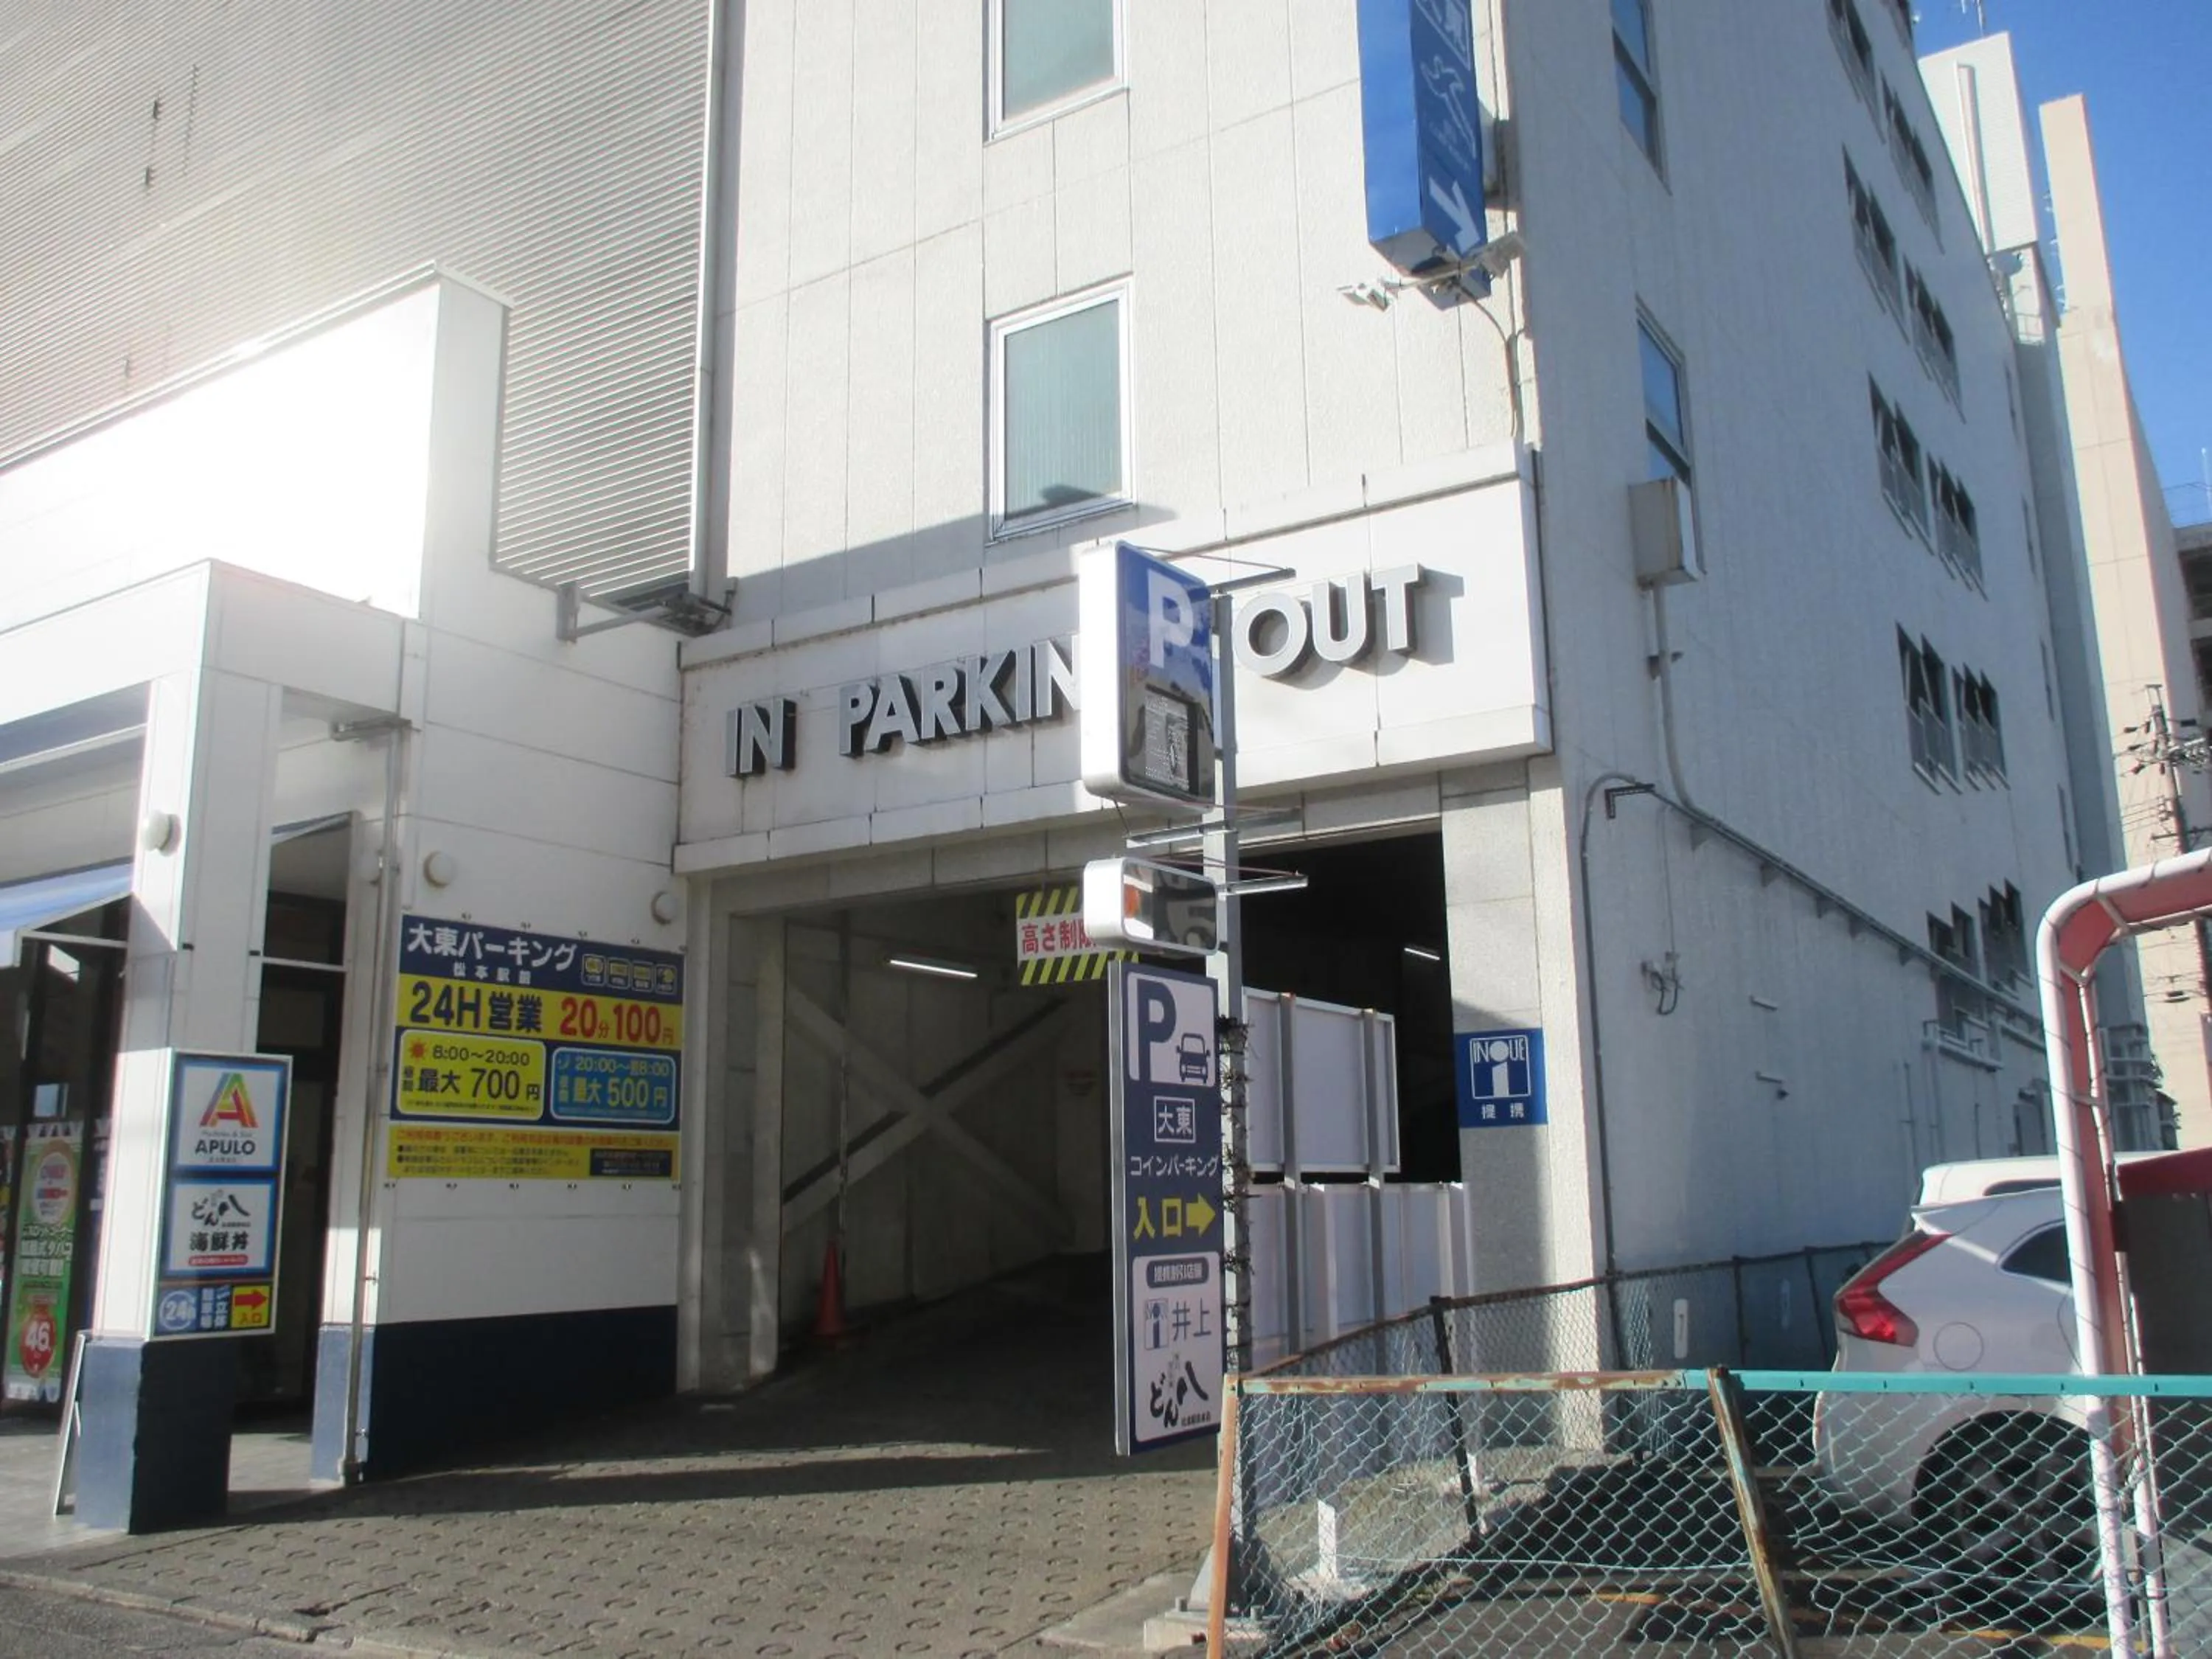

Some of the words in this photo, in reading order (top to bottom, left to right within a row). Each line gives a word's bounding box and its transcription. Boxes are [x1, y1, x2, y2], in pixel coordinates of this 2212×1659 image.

[1147, 568, 1194, 668] P
[726, 699, 795, 777] IN
[840, 634, 1081, 757] PARKIN
[1231, 563, 1425, 678] OUT
[407, 922, 579, 972] 大東パーキング
[1135, 978, 1177, 1085] P
[1158, 1105, 1194, 1137] 大東
[195, 1139, 256, 1155] APULO
[1130, 1155, 1219, 1178] コインパーキング
[1133, 1196, 1182, 1240] 入口
[1172, 1297, 1212, 1342] 井上
